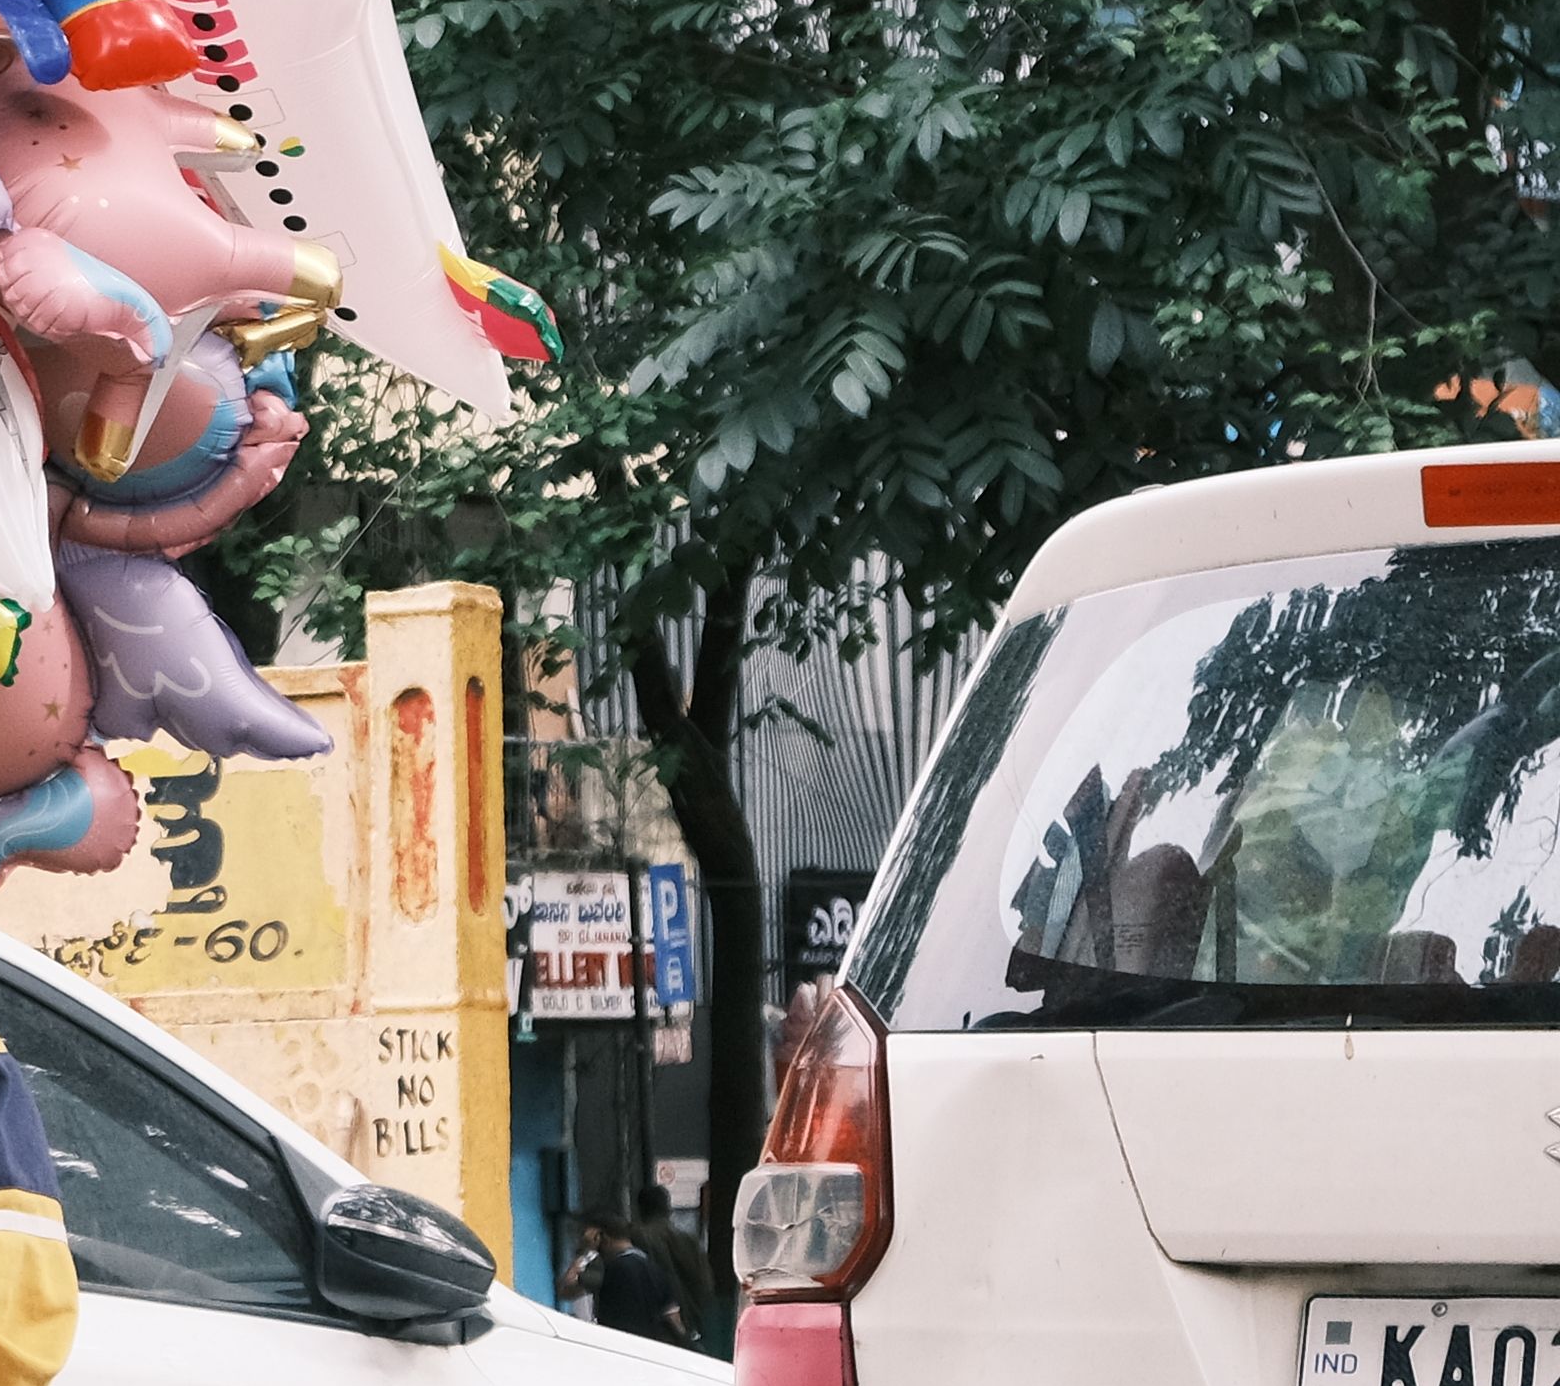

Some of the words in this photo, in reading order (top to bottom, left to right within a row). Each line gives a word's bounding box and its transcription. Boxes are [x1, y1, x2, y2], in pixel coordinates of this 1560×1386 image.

[659, 880, 678, 940] P
[378, 1027, 454, 1063] STICK
[397, 1075, 435, 1109] NO
[372, 1116, 450, 1158] BILLS
[1315, 1353, 1358, 1374] IND
